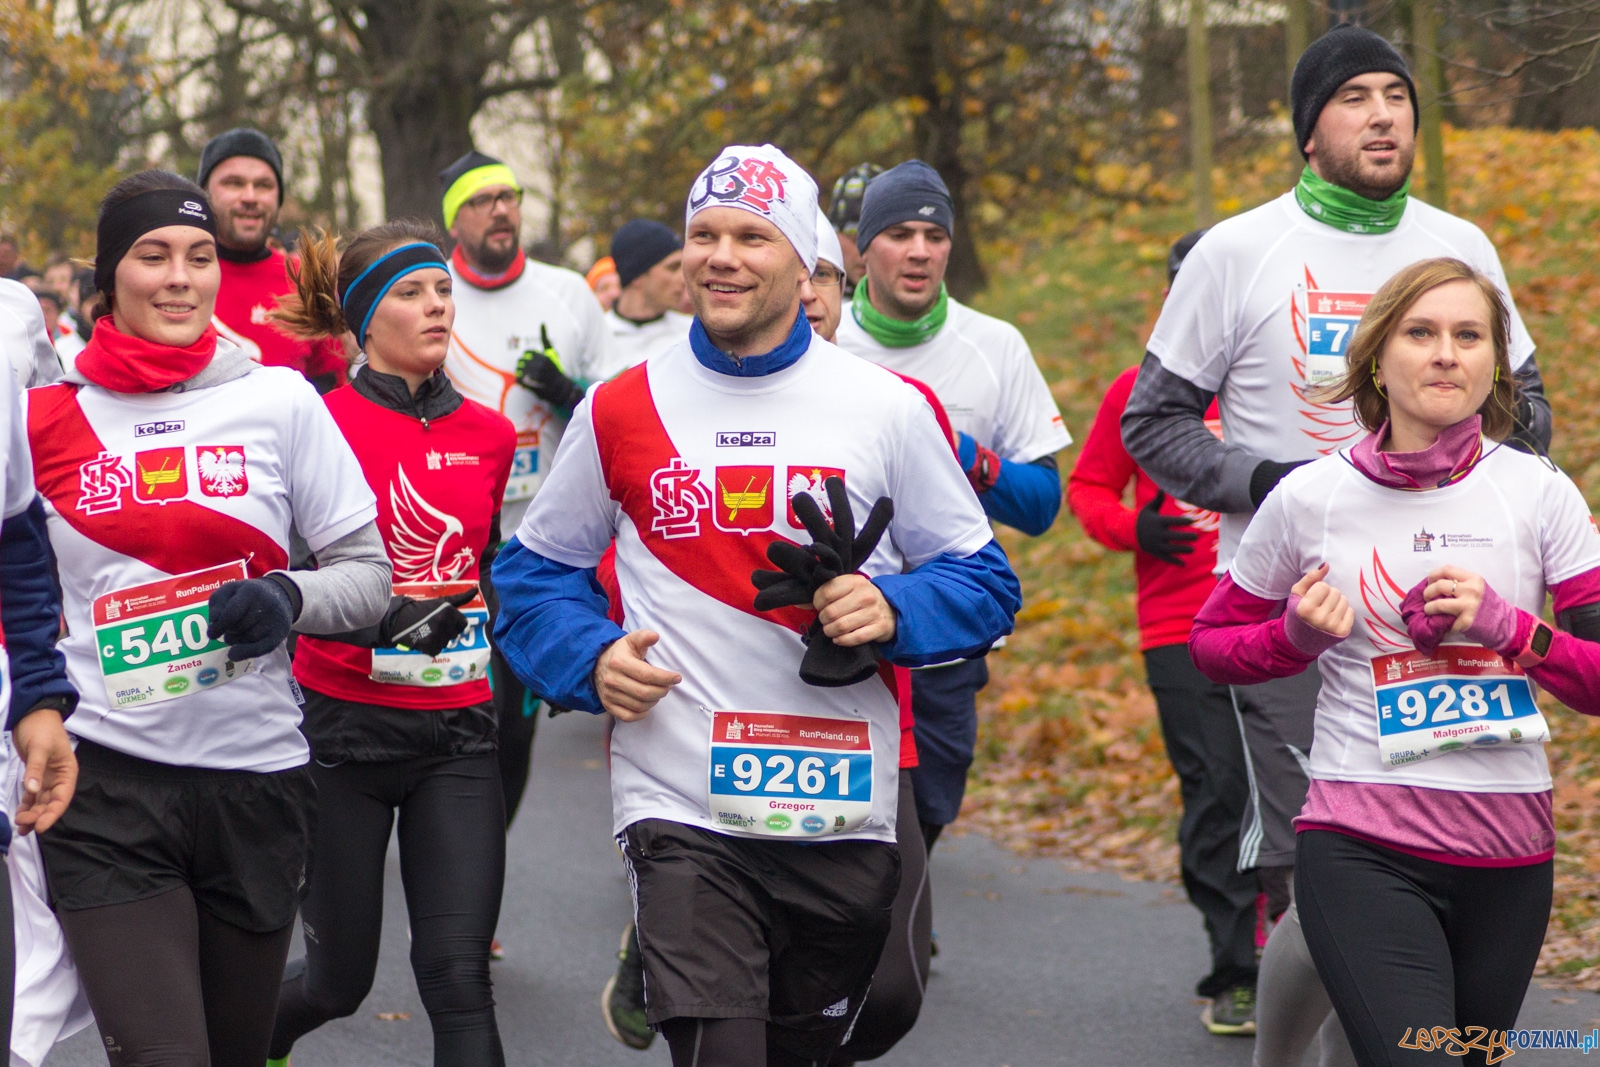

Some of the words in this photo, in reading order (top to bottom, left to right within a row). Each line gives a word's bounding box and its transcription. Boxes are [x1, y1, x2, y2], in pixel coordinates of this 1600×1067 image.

[1311, 330, 1322, 341] E
[1325, 322, 1360, 353] 7
[1439, 533, 1449, 548] 1
[123, 598, 133, 612] 1
[121, 613, 226, 665] 540
[167, 659, 203, 674] Żaneta
[1405, 660, 1415, 674] 1
[115, 687, 142, 698] GRUPA
[117, 693, 147, 705] LUXMED
[1381, 705, 1393, 719] E
[1397, 683, 1514, 727] 9281
[747, 723, 755, 737] 1
[799, 729, 860, 744] RunPoland.org
[1433, 724, 1491, 739] Małgorzata
[1389, 749, 1416, 760] GRUPA
[1391, 754, 1422, 766] LUXMED
[714, 764, 726, 778] E
[732, 753, 850, 796] 9261
[769, 801, 815, 812] Grzegorz
[718, 811, 743, 820] GRUPA
[719, 818, 748, 827] LUXMED
